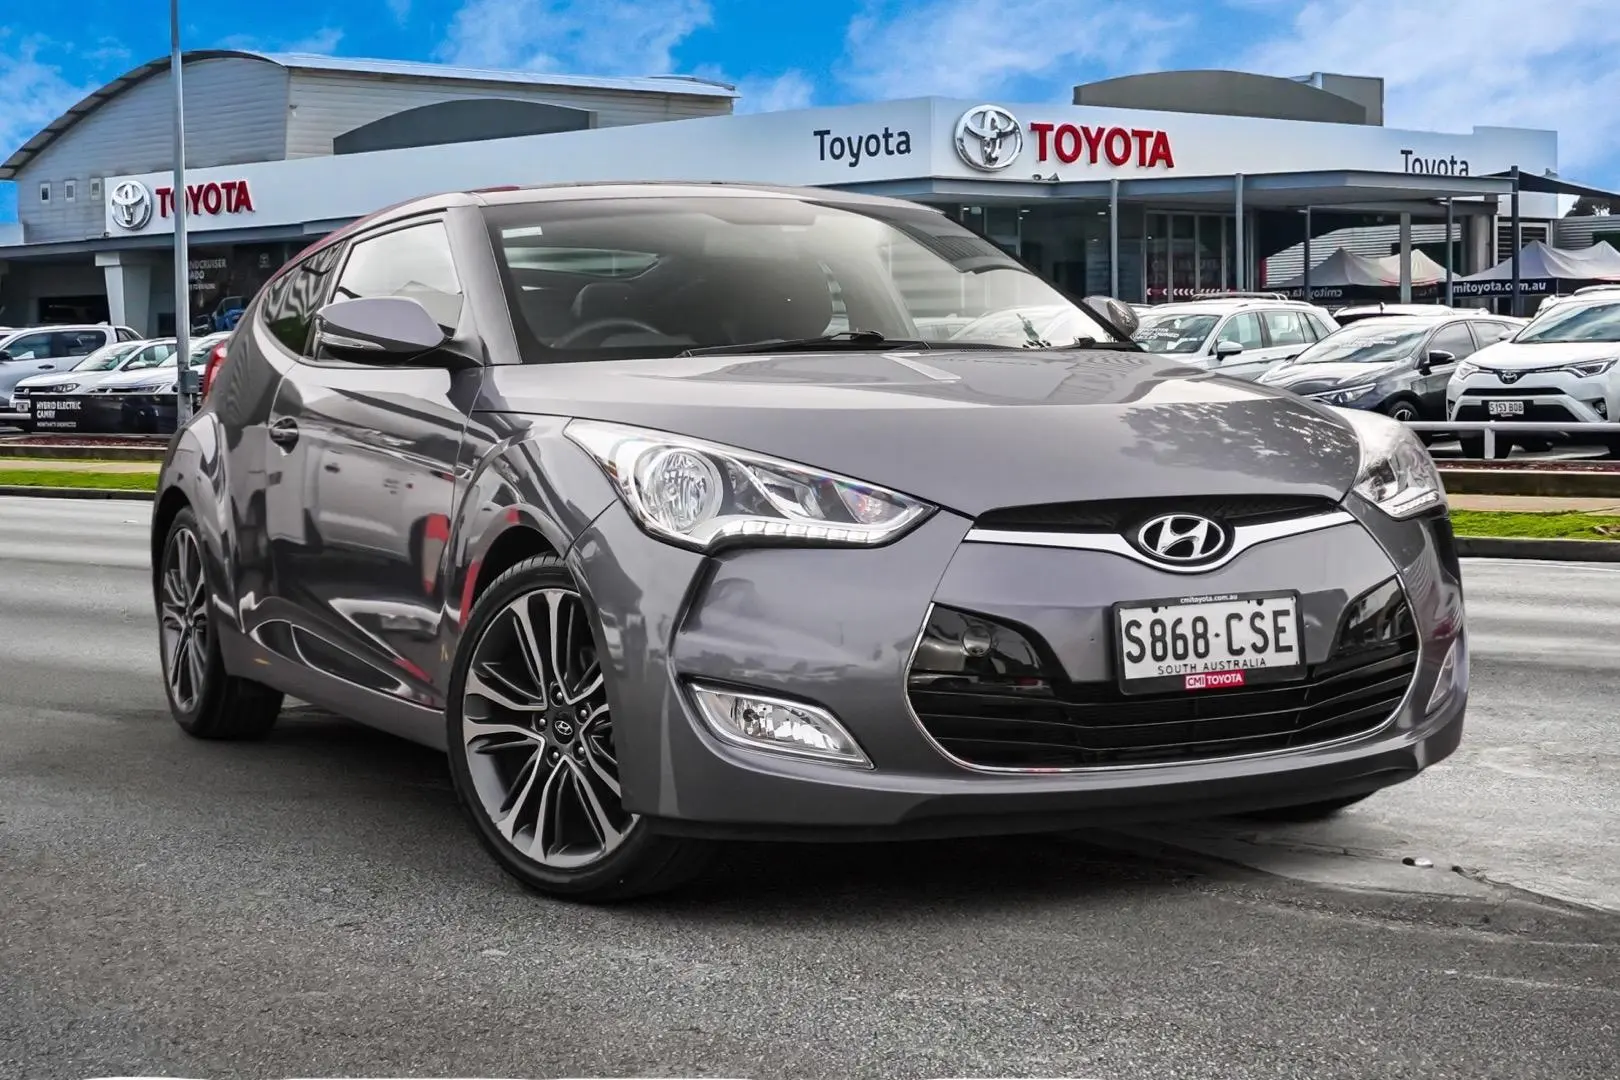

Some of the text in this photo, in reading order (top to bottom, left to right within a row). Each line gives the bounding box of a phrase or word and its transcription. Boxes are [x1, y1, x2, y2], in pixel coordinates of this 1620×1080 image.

[814, 127, 911, 167] Toyota
[1030, 122, 1174, 169] TOYOTA
[1453, 281, 1547, 294] mitoyota.cm.au
[57, 401, 82, 410] ELECTRIC
[1180, 594, 1238, 604] cmitoyota.com.au
[1157, 658, 1267, 675] SOUTH AUSTRALIA
[1186, 673, 1244, 687] CMI TOYOTA
